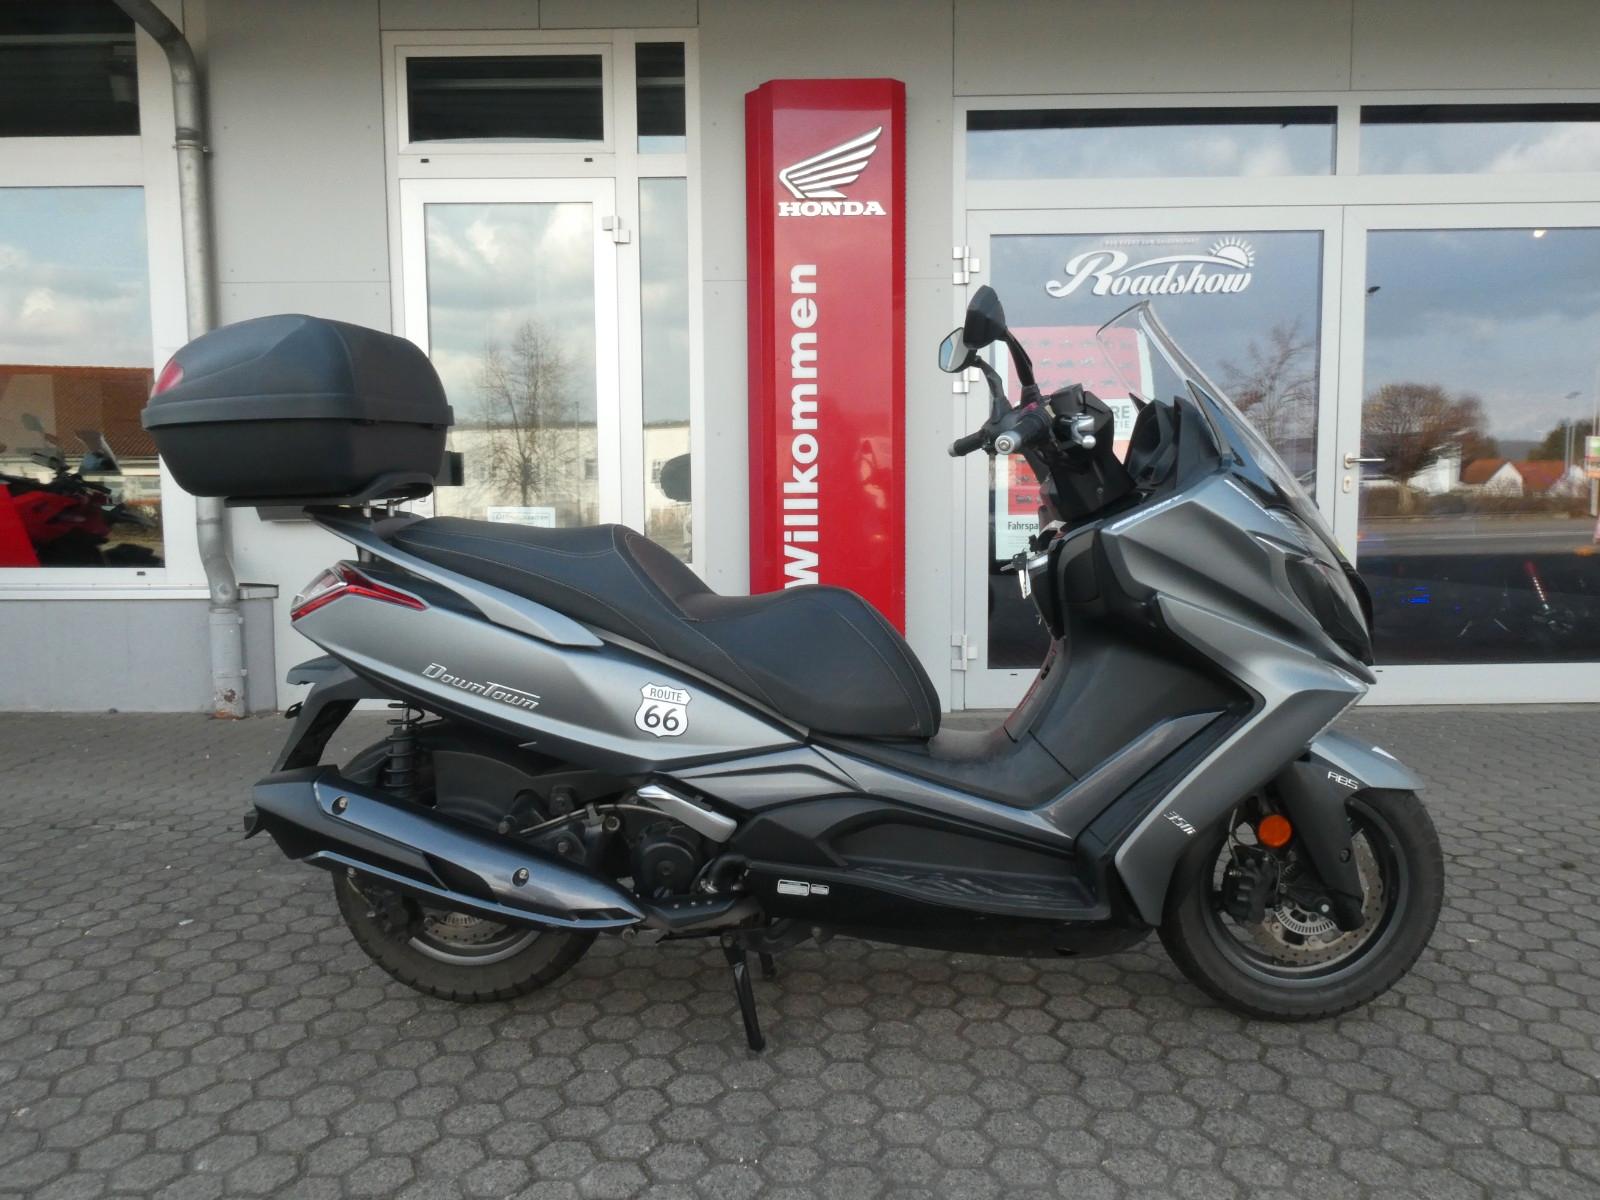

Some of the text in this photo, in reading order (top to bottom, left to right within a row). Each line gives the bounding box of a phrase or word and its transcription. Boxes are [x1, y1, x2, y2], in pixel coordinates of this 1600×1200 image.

[778, 201, 887, 217] HONDA
[1045, 249, 1252, 298] Roadshow
[784, 263, 819, 589] Willkommen
[421, 662, 542, 710] DownTown
[650, 687, 682, 702] ROUTE
[643, 704, 680, 732] 66
[1327, 770, 1360, 790] ABS
